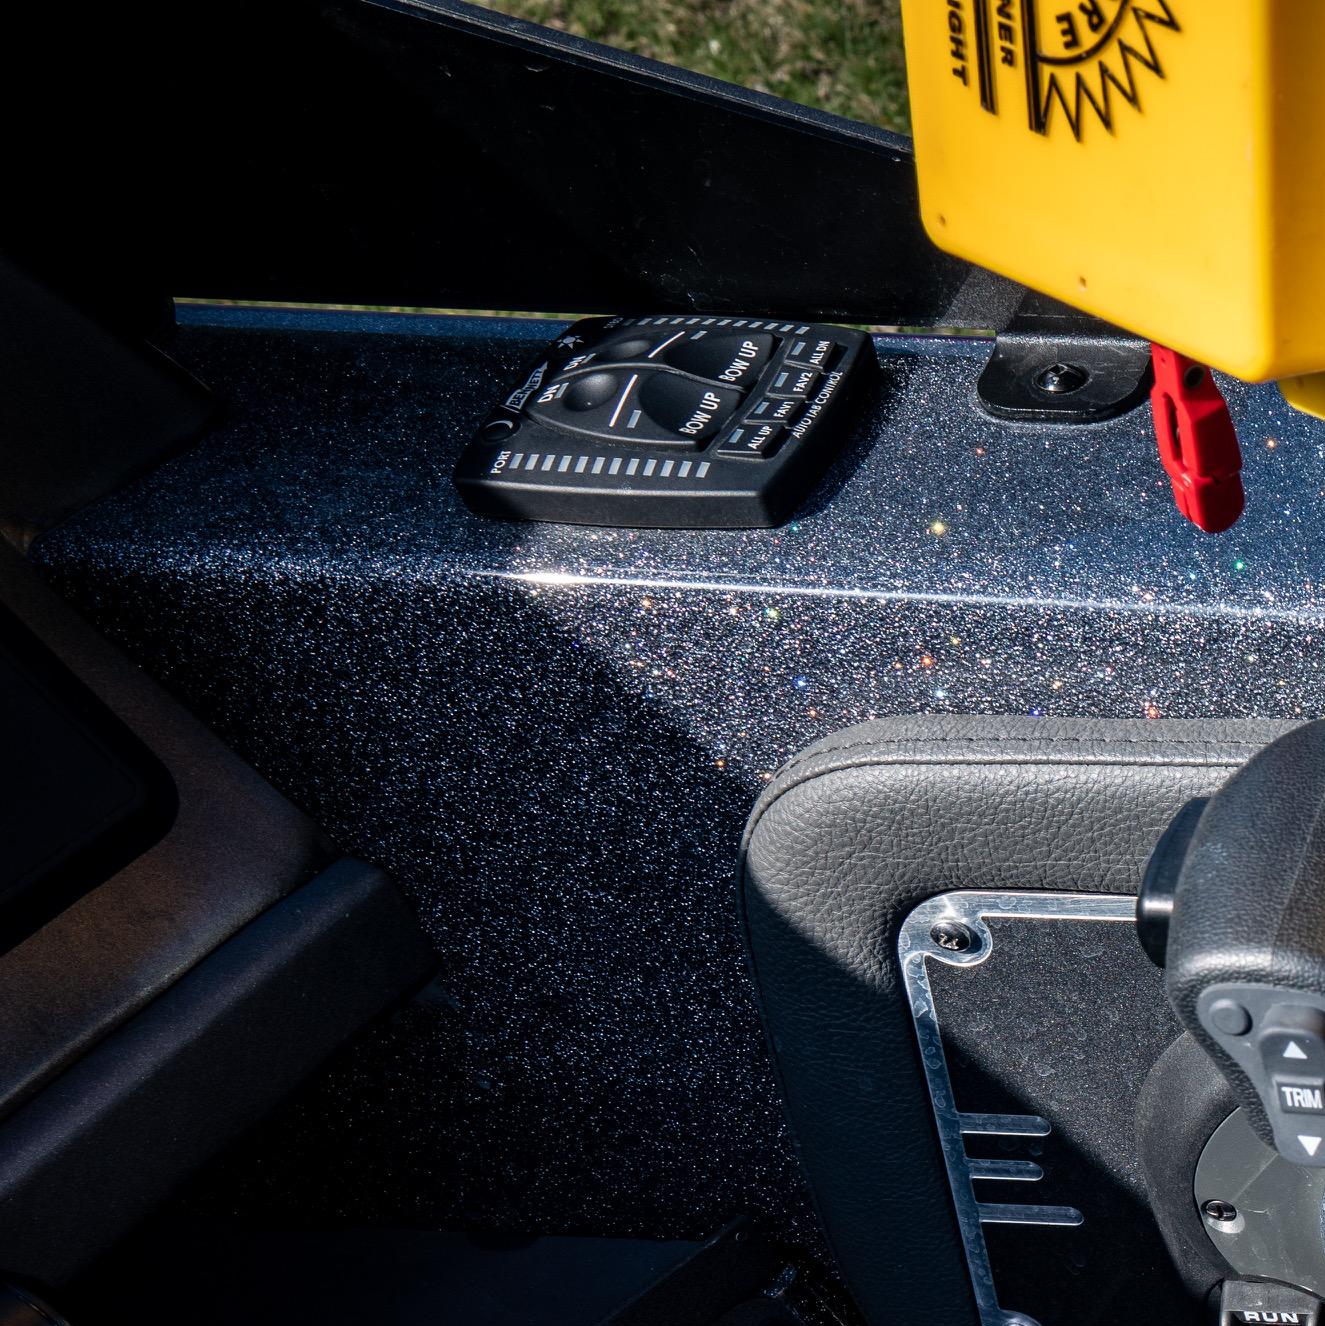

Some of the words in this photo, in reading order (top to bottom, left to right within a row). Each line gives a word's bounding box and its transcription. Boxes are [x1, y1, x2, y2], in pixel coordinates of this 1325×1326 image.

[809, 350, 825, 364] ALL
[816, 340, 831, 352] DN
[718, 360, 751, 382] BOW
[739, 341, 760, 358] UP
[511, 368, 544, 408] BENNETT
[793, 371, 813, 392] FAV2
[537, 384, 560, 403] DN
[791, 416, 813, 439] AUTO
[806, 403, 822, 420] TAB
[818, 371, 843, 405] CONTROL
[678, 412, 713, 435] BOW
[700, 392, 721, 411] UP
[773, 401, 795, 418] FAV1
[747, 434, 765, 450] ALL
[760, 425, 773, 438] UP
[490, 450, 512, 473] PORT
[1281, 1086, 1323, 1109] TRIM
[1243, 1311, 1299, 1323] RUN
